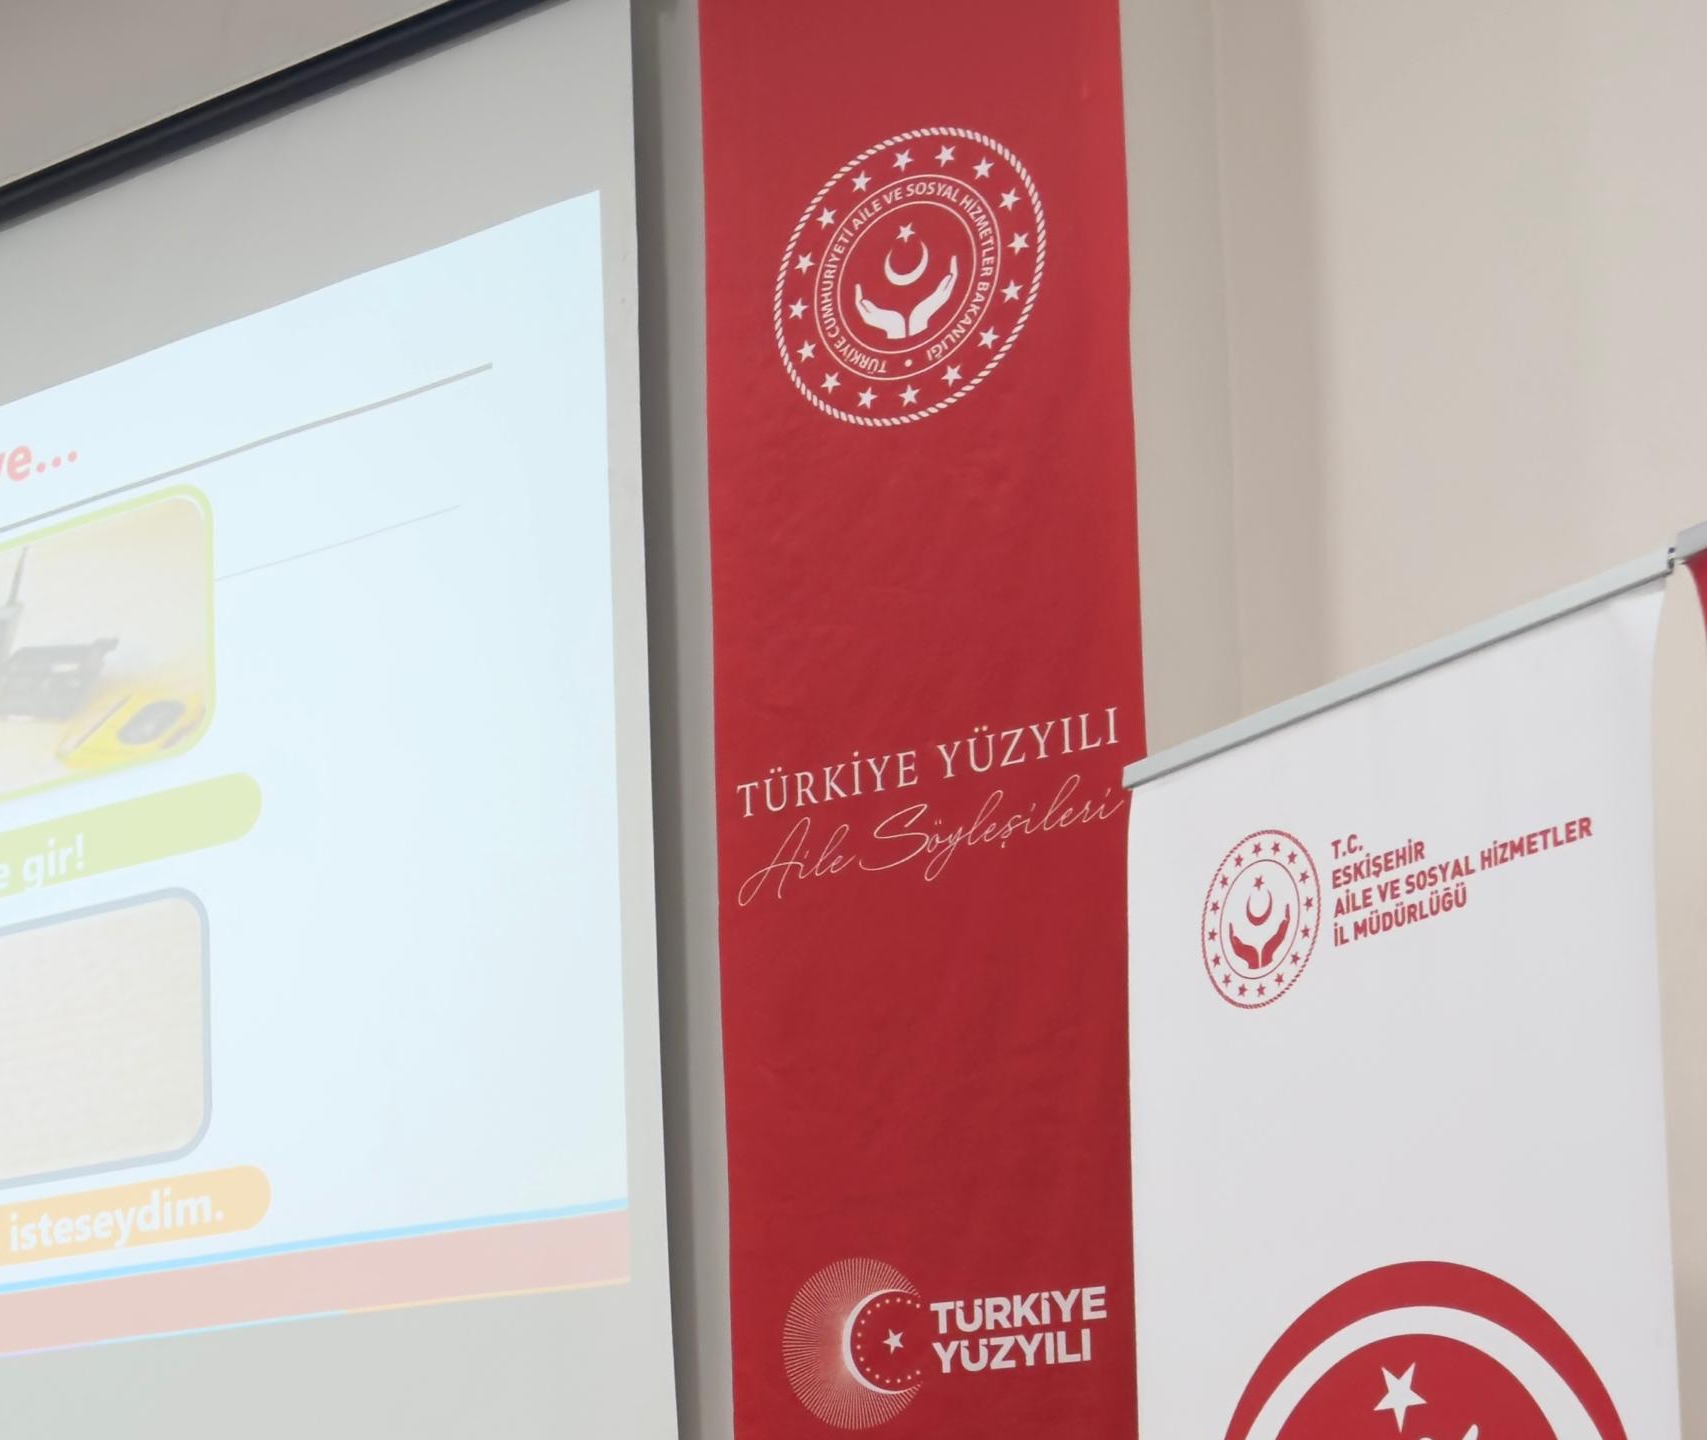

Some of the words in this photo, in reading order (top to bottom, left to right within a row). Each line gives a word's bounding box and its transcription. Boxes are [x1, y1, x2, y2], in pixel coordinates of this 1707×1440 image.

[852, 200, 883, 230] AİLE
[883, 187, 903, 204] VE
[906, 181, 960, 202] SOSYAL
[959, 194, 995, 277] HİZMETLER
[820, 226, 854, 338] CUMHURİYETİ
[926, 281, 990, 361] BAKANLIĞI
[834, 335, 887, 374] TÜRKİYE
[736, 750, 918, 819] TÜRKİYE
[937, 707, 1119, 779] YÜZYILI
[22, 833, 86, 893] gir!
[737, 816, 857, 907] Aile
[859, 774, 1125, 882] Söyleşileri
[1331, 833, 1363, 860] T.C.
[1331, 838, 1426, 890] ESKİŞEHİR
[1333, 888, 1373, 918] AİLE
[1377, 878, 1400, 904] VE
[1405, 855, 1475, 896] SOSYAL
[1480, 816, 1594, 872] HİZMETLER
[1333, 920, 1350, 947] İL
[1353, 886, 1468, 941] MÜDÜRLÜĞÜ
[9, 1188, 225, 1251] isteseydim.
